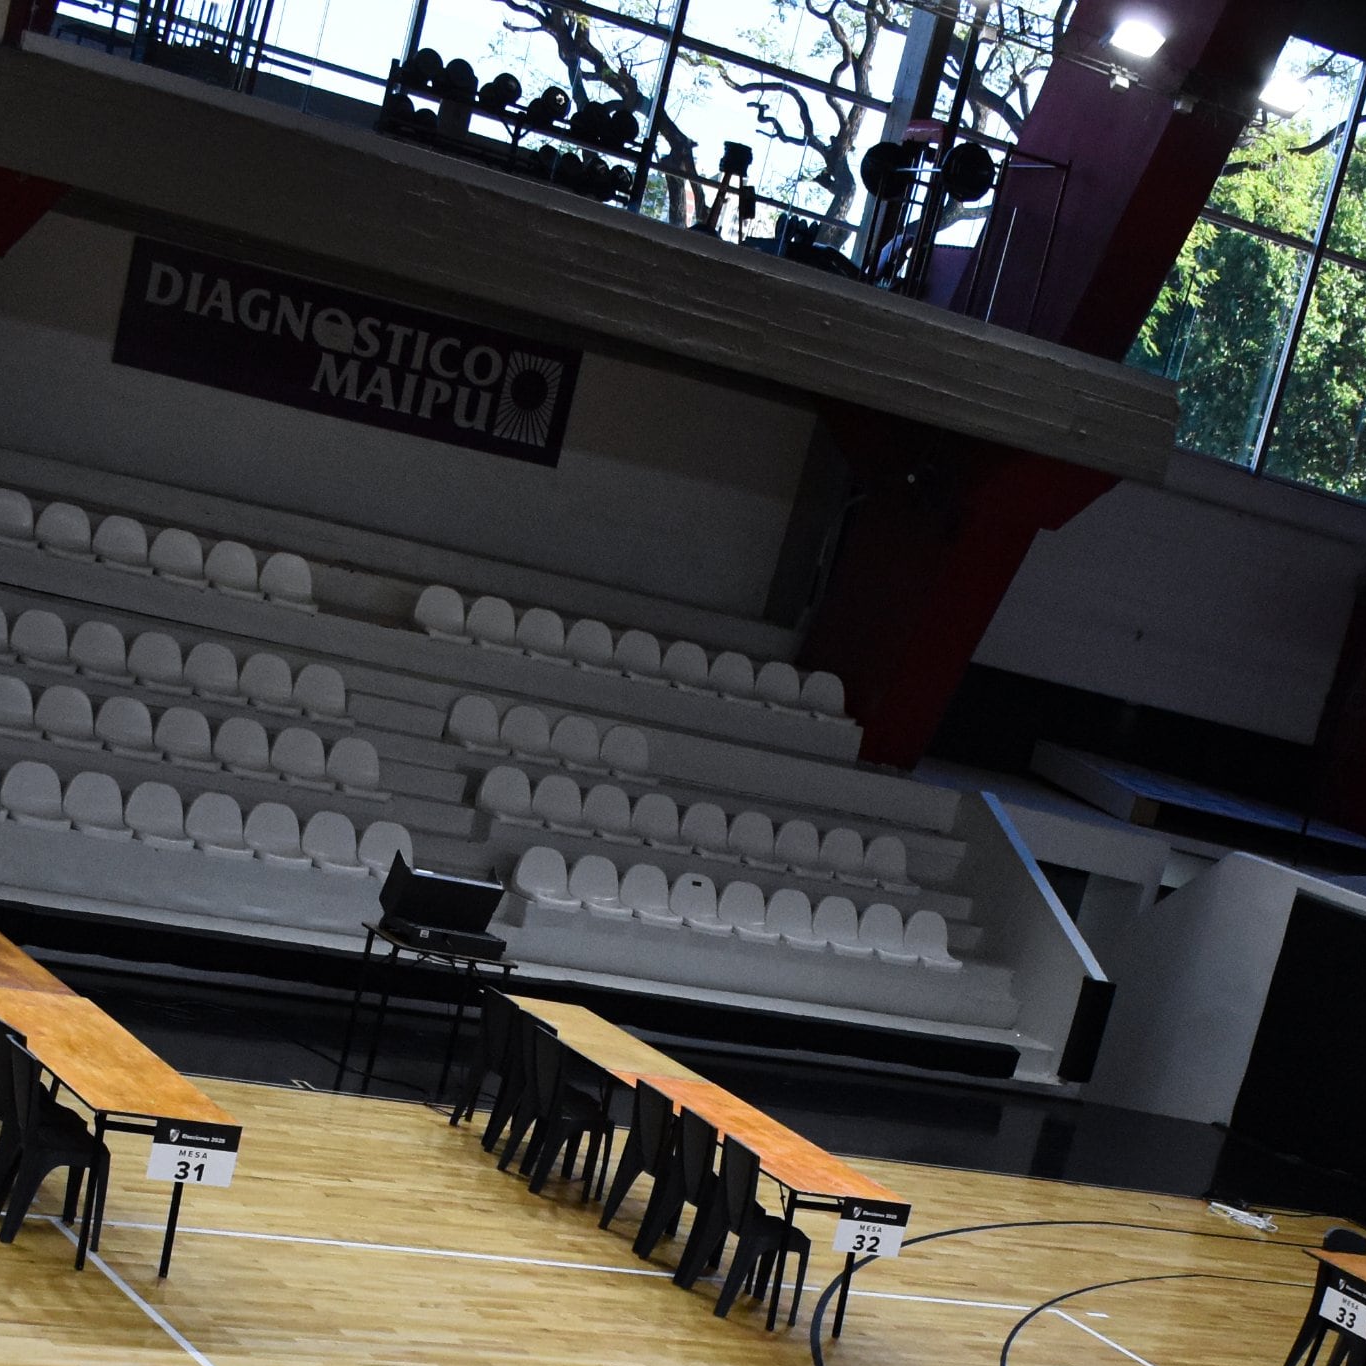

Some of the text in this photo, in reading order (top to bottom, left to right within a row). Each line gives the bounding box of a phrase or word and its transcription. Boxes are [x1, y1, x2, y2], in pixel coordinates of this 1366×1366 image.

[145, 260, 503, 387] DIAGNOSTICO
[310, 351, 494, 432] MAIPU
[178, 1149, 208, 1160] MESA
[174, 1160, 205, 1182] 31
[859, 1224, 882, 1233] MESA
[852, 1234, 880, 1253] 32
[1335, 1307, 1357, 1329] 33
